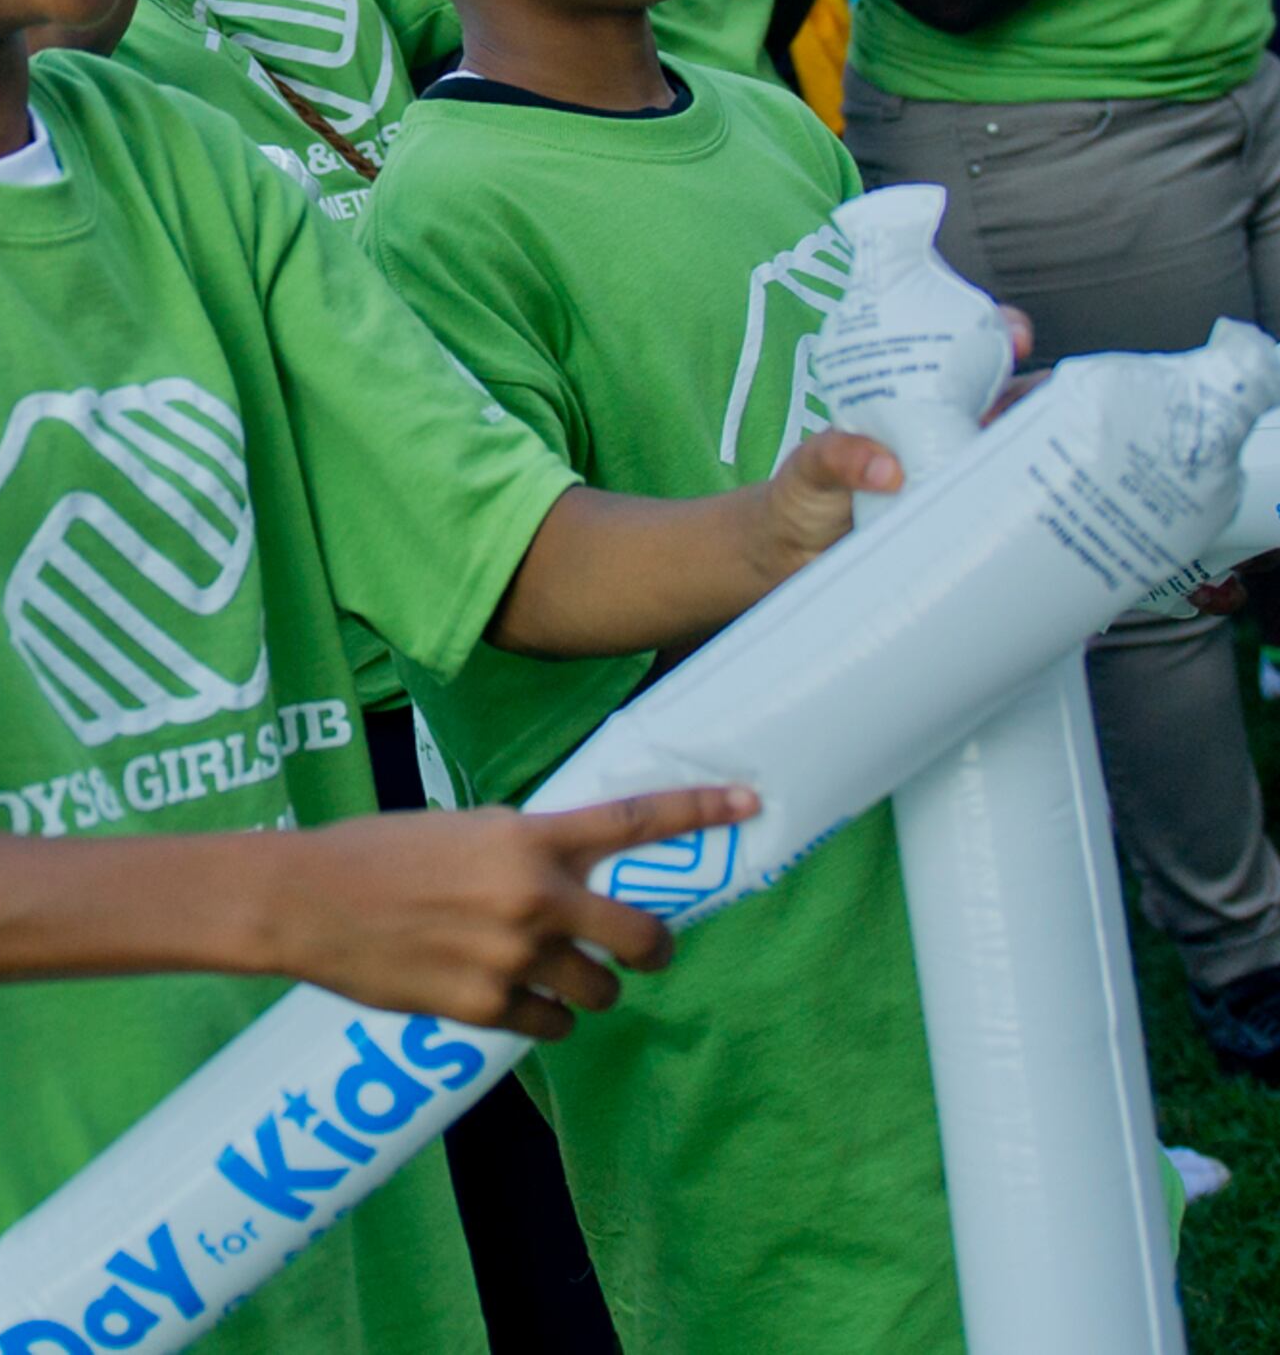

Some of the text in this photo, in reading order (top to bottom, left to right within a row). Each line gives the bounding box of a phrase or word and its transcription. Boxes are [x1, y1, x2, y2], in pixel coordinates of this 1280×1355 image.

[122, 724, 282, 814] GIRLS
[216, 1012, 487, 1224] Kids
[197, 1217, 261, 1265] for
